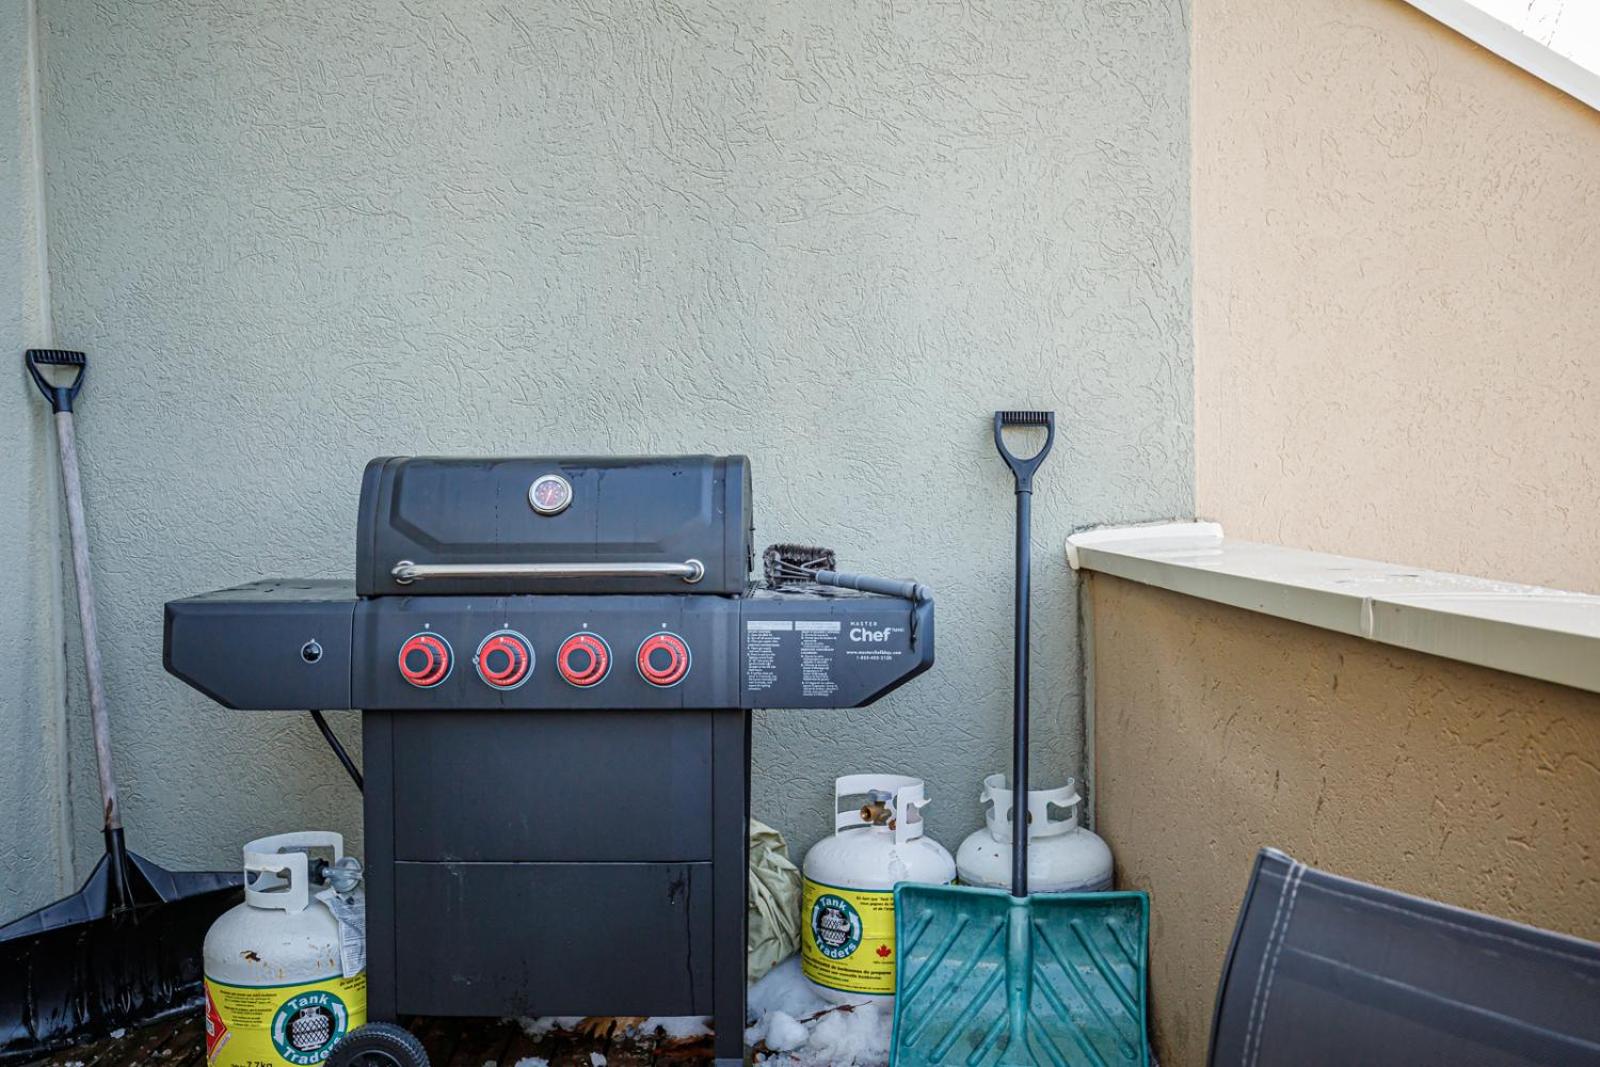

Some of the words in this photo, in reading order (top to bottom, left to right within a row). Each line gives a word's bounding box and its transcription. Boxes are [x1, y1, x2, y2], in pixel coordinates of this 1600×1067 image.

[849, 627, 892, 642] Chef
[819, 897, 847, 911] Tank
[816, 936, 857, 959] Traders
[287, 993, 329, 1010] Tank
